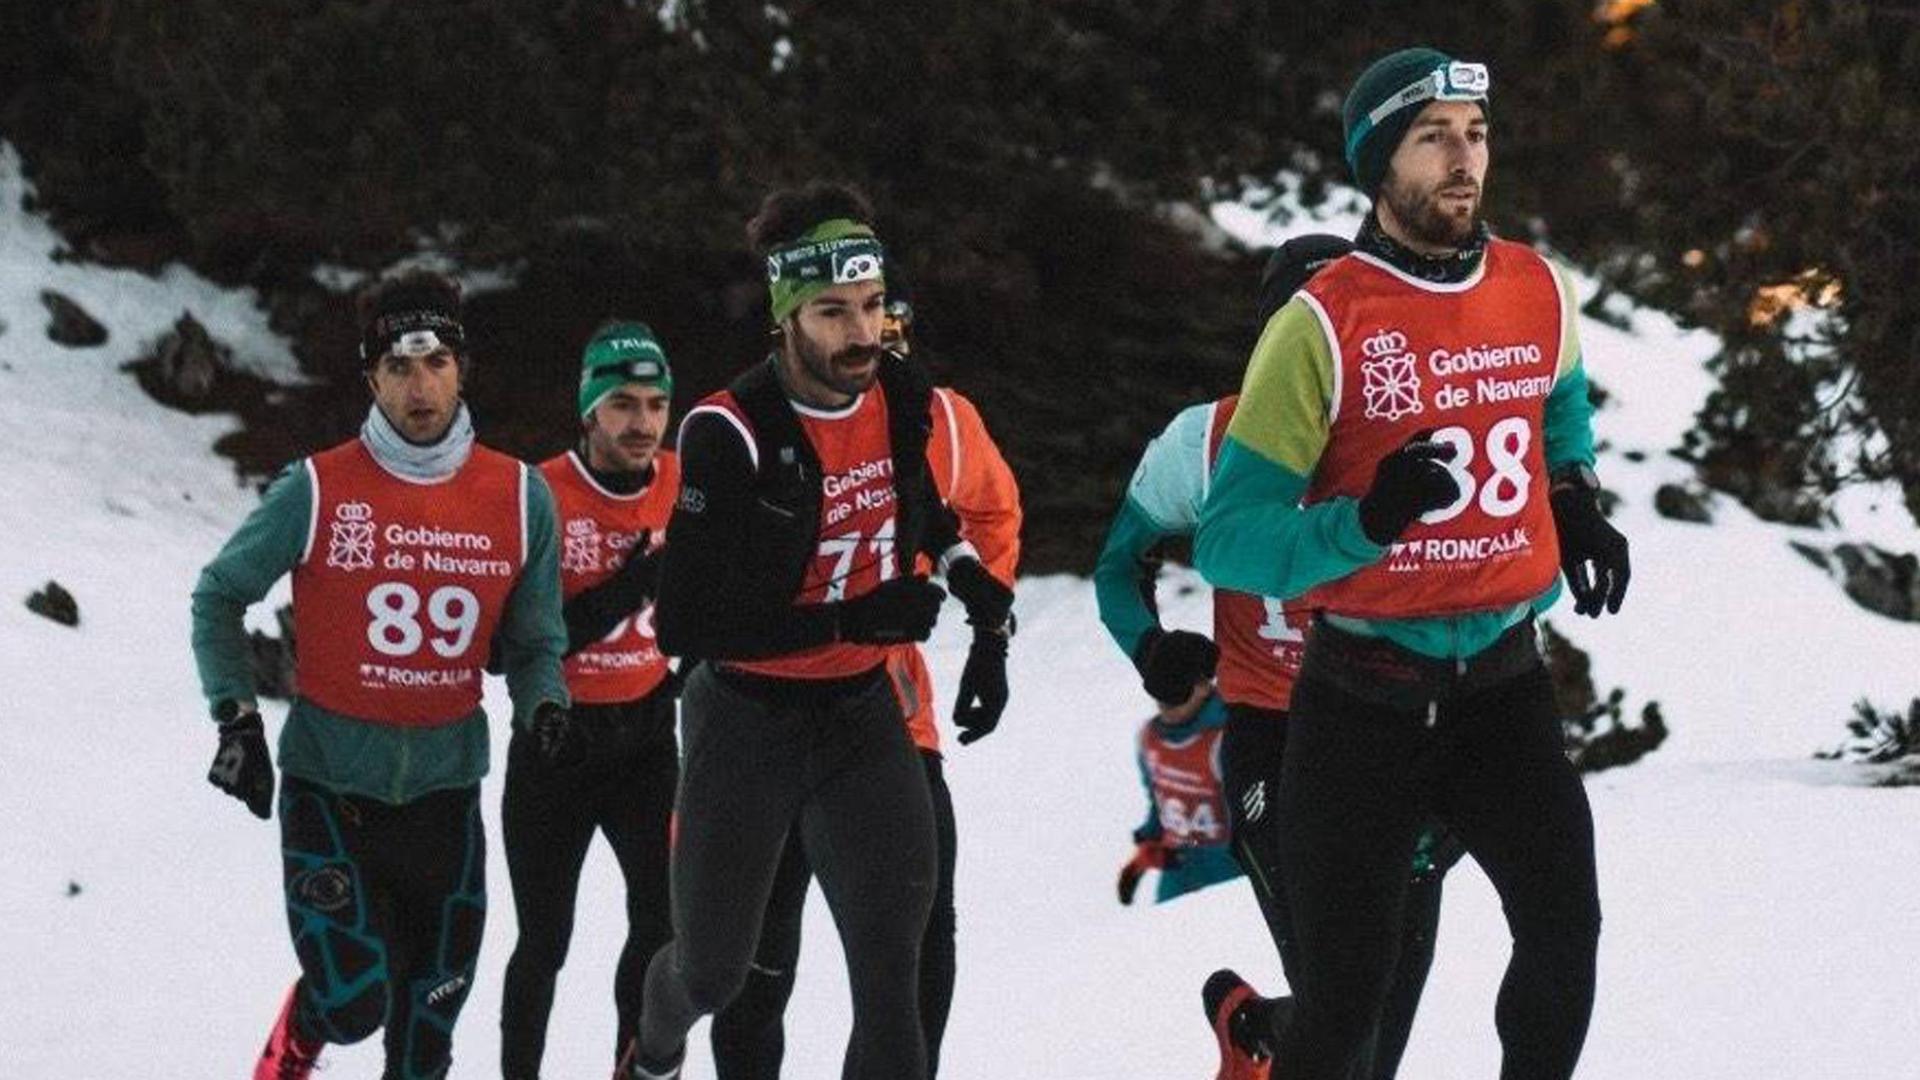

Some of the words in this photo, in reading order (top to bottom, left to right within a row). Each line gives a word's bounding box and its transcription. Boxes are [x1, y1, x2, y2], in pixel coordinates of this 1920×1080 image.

[1429, 344, 1541, 375] Gobierno
[1435, 386, 1470, 409] de
[384, 524, 491, 550] Gobierno
[384, 551, 415, 570] de
[423, 552, 512, 576] Navarra
[818, 518, 895, 603] 71
[366, 581, 480, 658] 89
